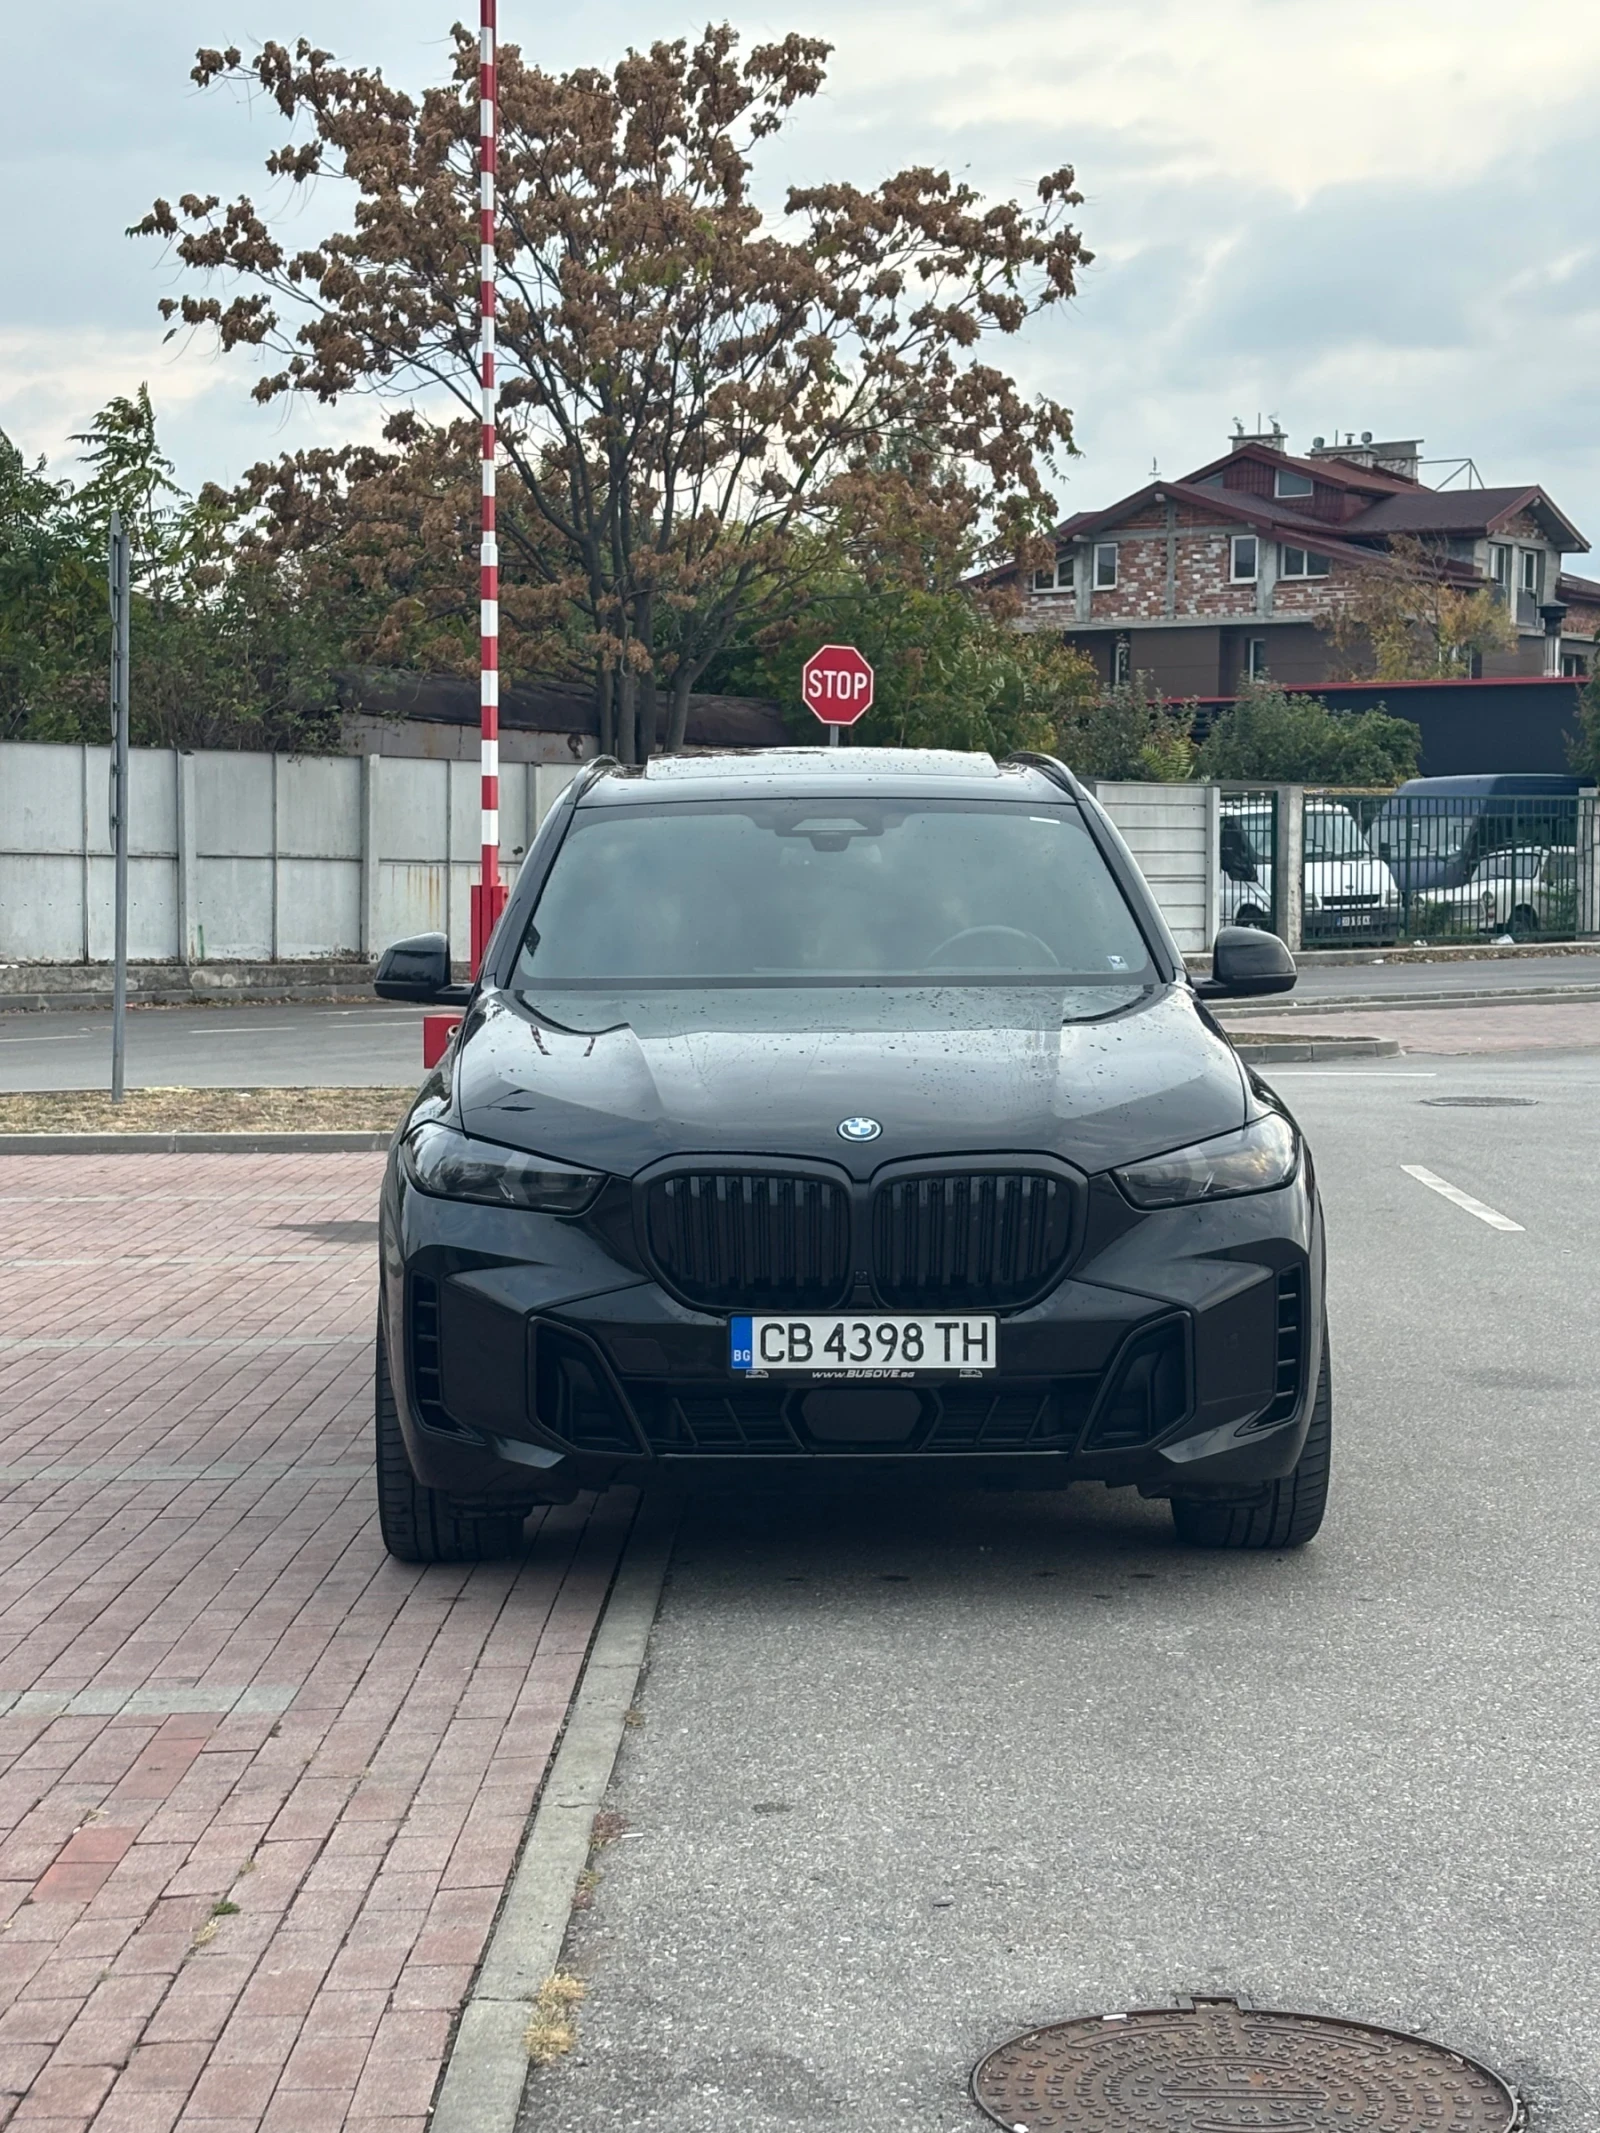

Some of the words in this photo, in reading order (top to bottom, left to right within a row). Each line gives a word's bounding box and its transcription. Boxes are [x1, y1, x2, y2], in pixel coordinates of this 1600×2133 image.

[808, 669, 868, 700] STOP
[733, 1349, 751, 1362] BG
[760, 1323, 814, 1362] CB
[823, 1322, 925, 1362] 4398
[935, 1322, 988, 1362] TH
